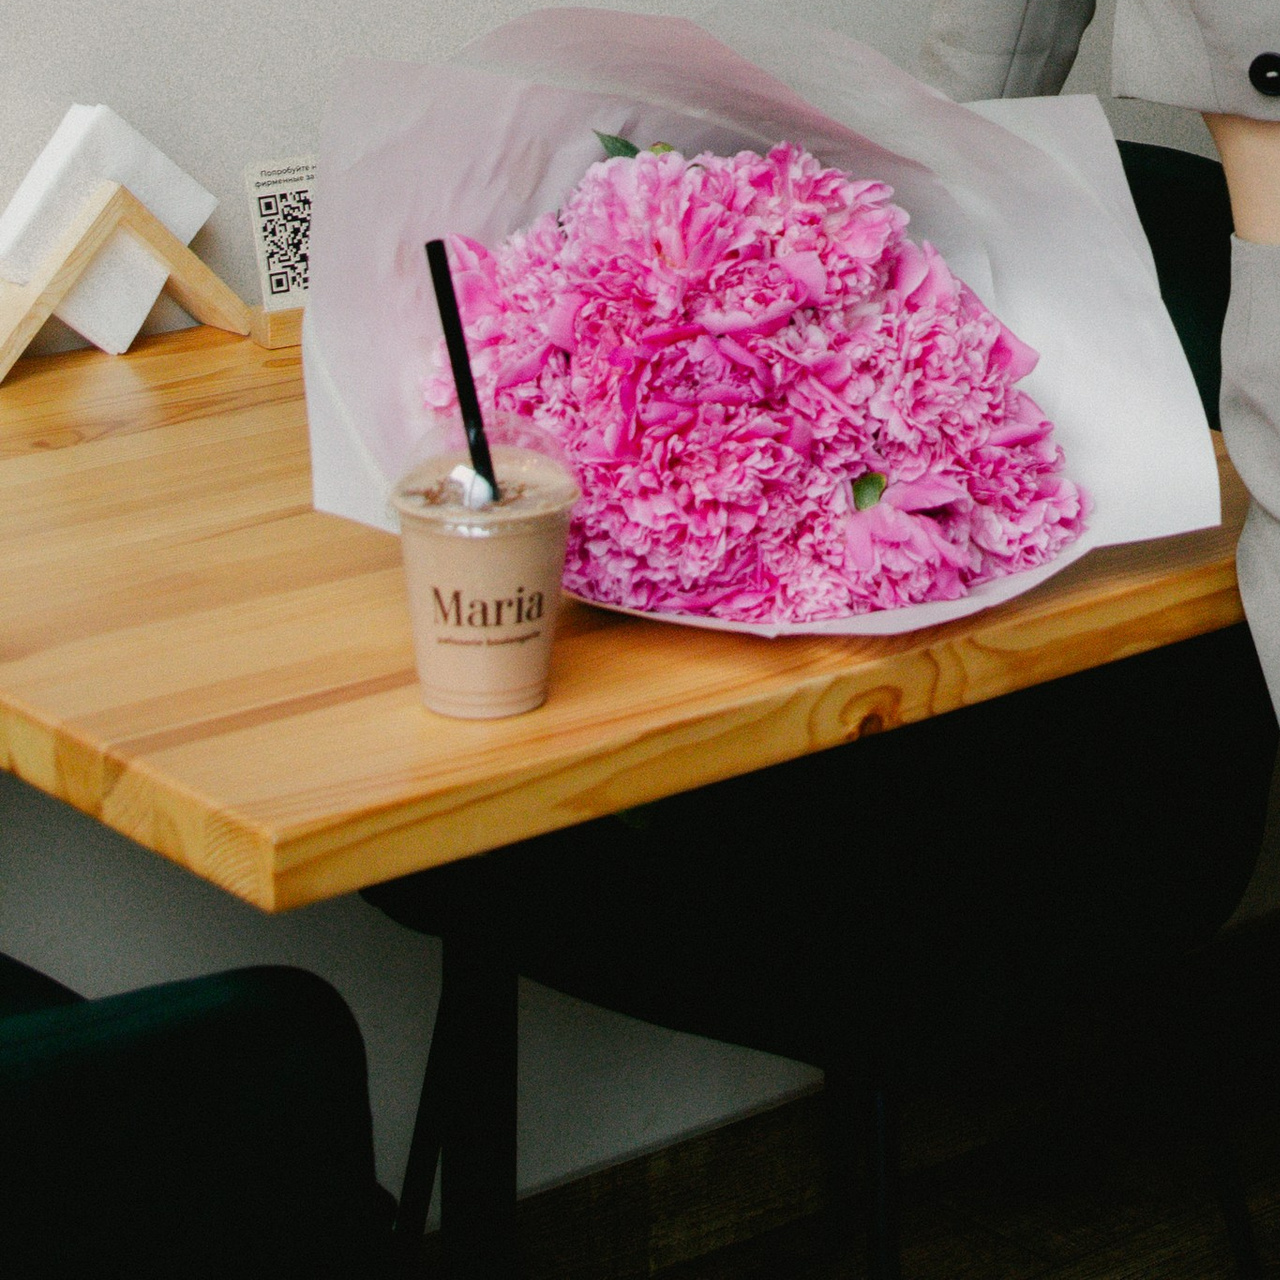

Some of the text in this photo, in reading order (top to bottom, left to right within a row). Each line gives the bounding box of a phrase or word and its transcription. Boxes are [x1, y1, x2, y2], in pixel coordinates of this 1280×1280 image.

[260, 165, 310, 177] Попробуйте
[255, 176, 304, 188] фирменные
[431, 585, 544, 627] Maria
